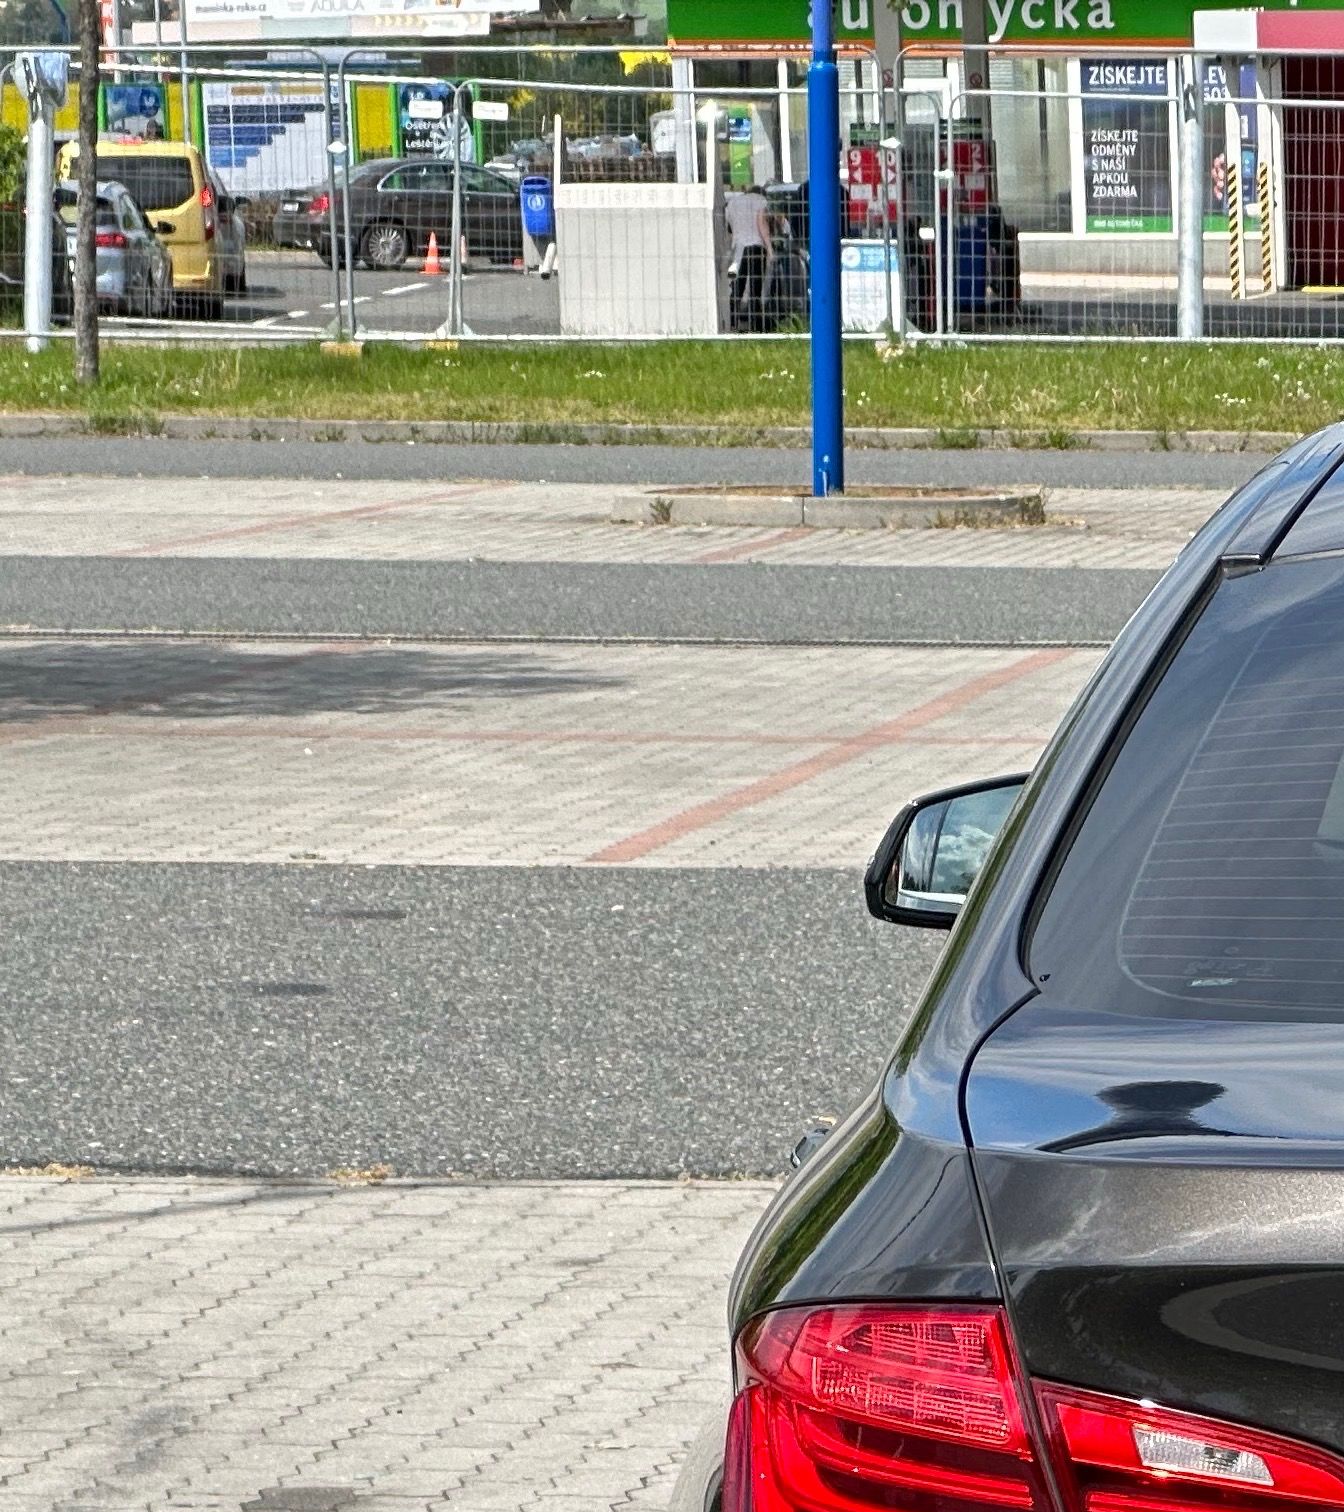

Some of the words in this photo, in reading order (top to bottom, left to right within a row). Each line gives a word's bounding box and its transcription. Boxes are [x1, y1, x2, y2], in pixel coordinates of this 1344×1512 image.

[1088, 62, 1166, 86] ZÍSKEJTE
[1091, 127, 1138, 142] ZÍSKEJTE
[1091, 143, 1137, 156] ODMĚNY
[850, 151, 862, 165] 9
[1091, 159, 1099, 171] S
[1102, 157, 1126, 171] NAŠÍ
[1093, 173, 1128, 184] APKOU
[1093, 186, 1138, 198] ZDARMA
